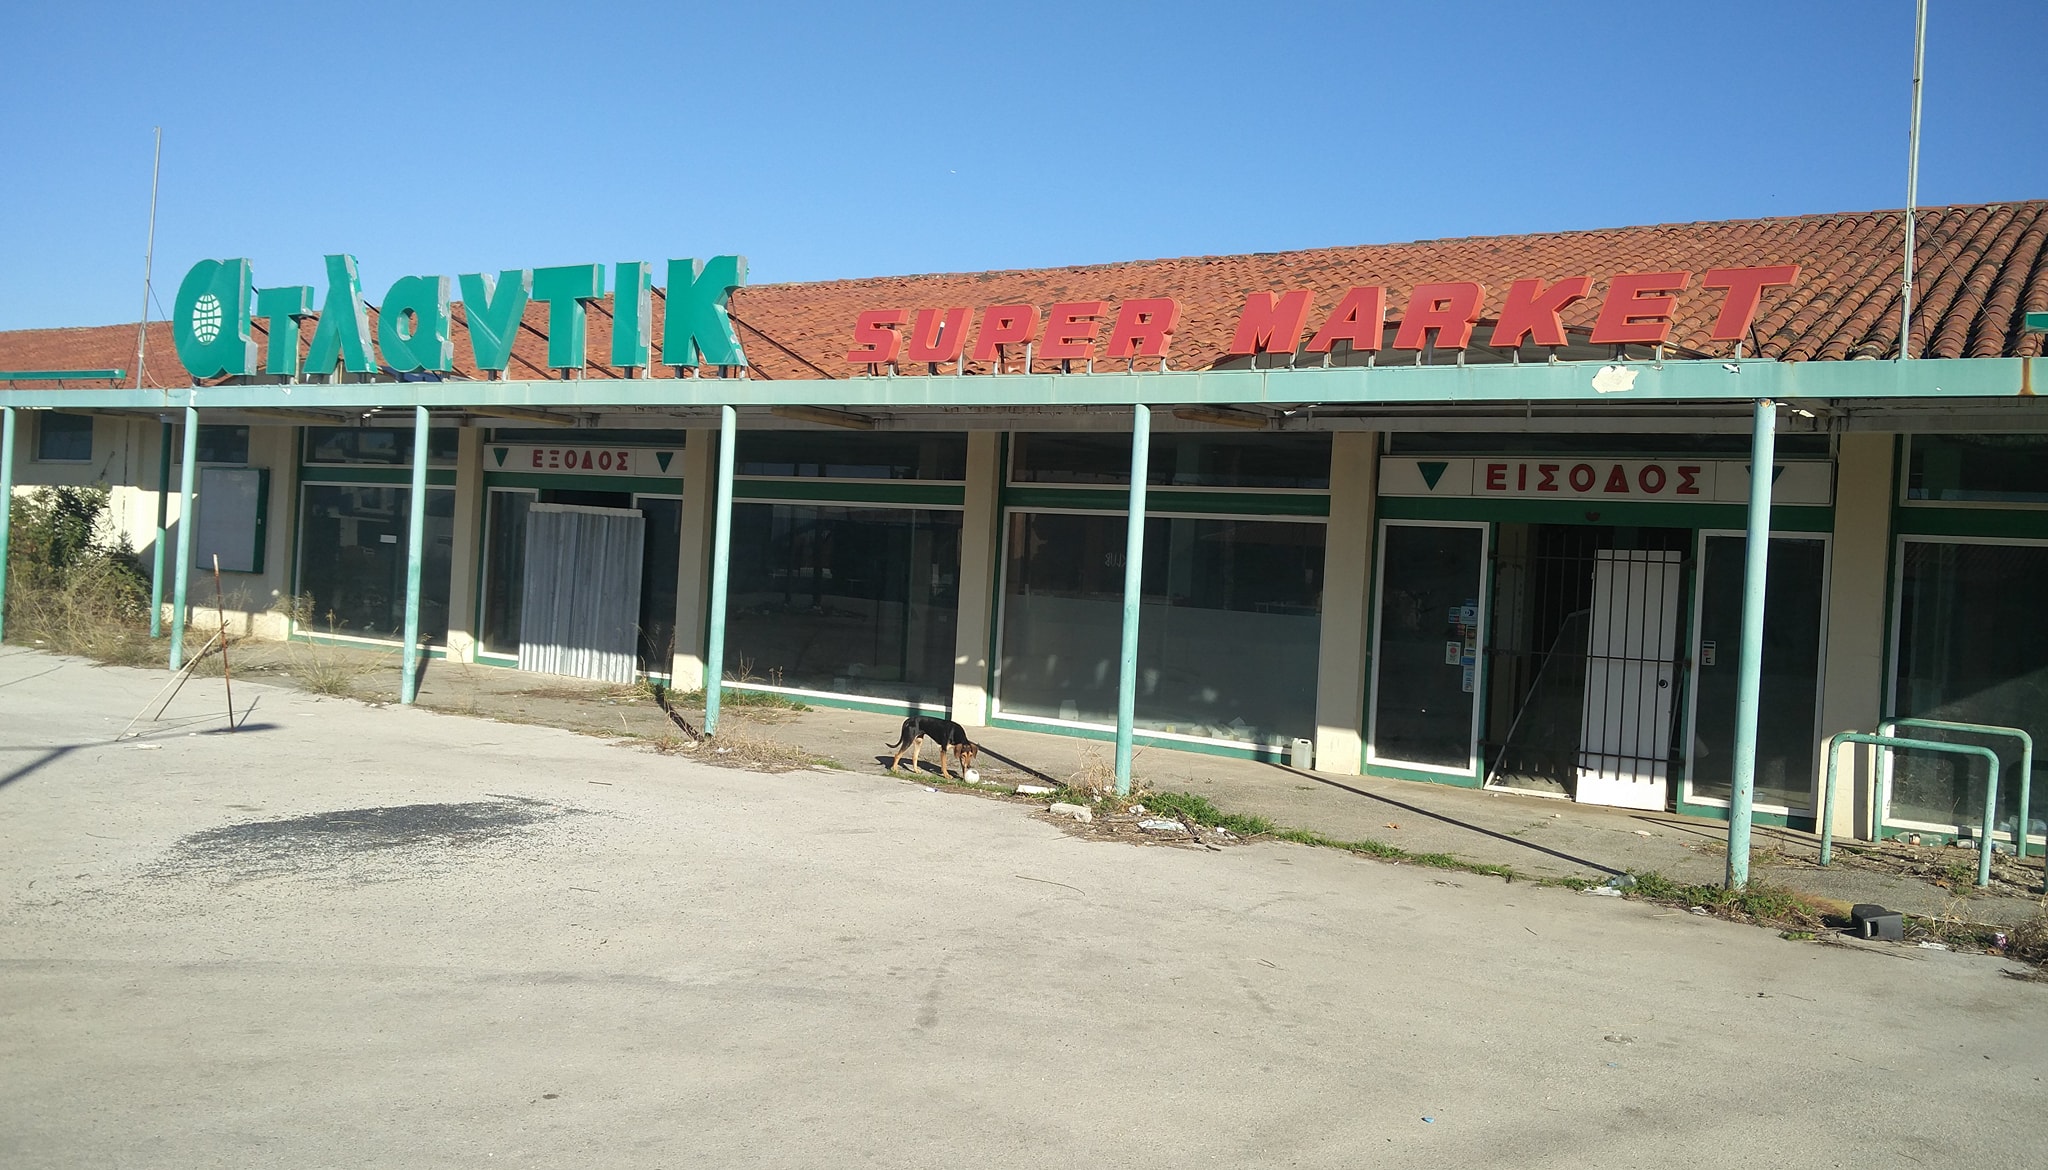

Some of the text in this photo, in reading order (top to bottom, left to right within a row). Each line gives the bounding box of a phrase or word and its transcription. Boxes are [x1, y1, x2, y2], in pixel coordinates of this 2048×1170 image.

[847, 265, 1802, 363] SUPER MARKET
[532, 449, 628, 471] ΕΞΟΔΟΣ
[1486, 463, 1701, 495] ΕΙΣΟΔΟΣ
